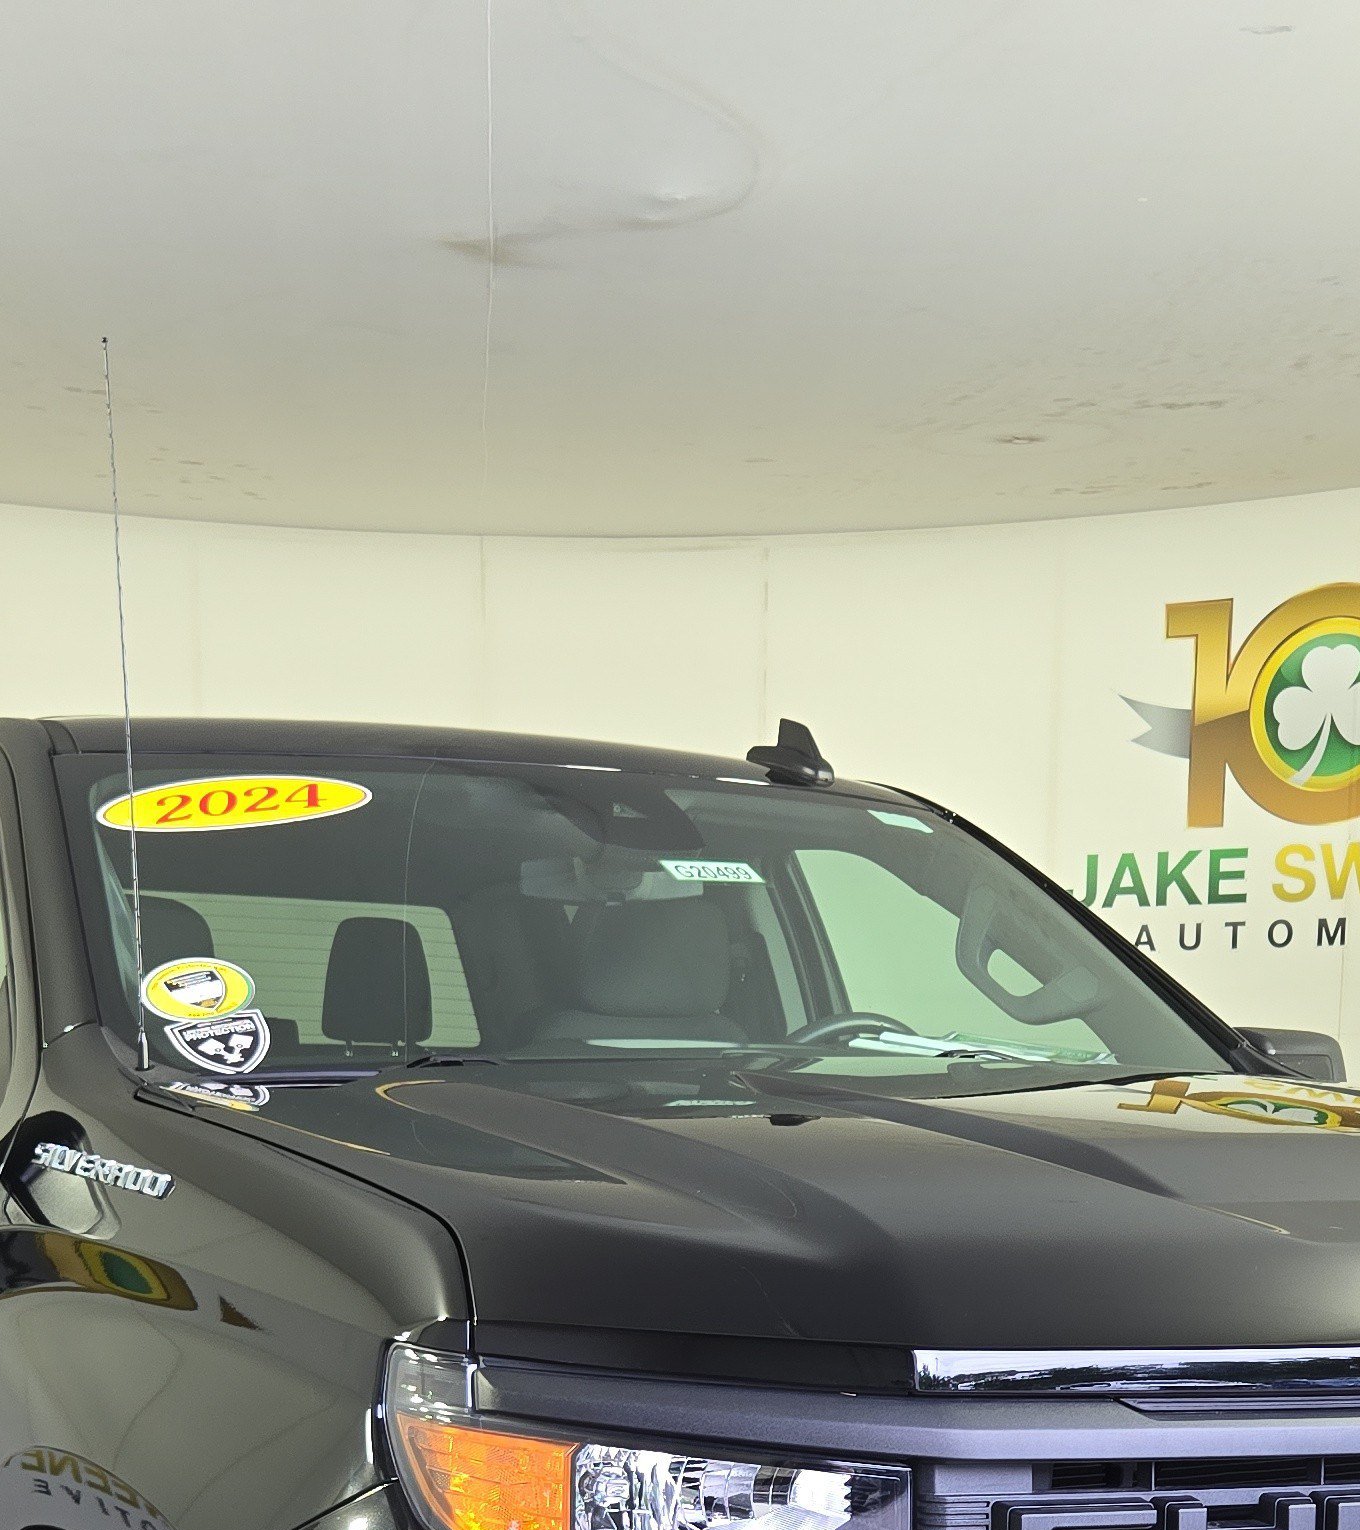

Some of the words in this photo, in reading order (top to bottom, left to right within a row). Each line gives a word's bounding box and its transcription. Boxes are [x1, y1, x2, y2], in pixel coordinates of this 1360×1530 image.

[155, 783, 328, 825] 2024
[674, 864, 753, 880] G20499
[1065, 848, 1249, 908] JAKE
[31, 1142, 175, 1199] SILVERADO
